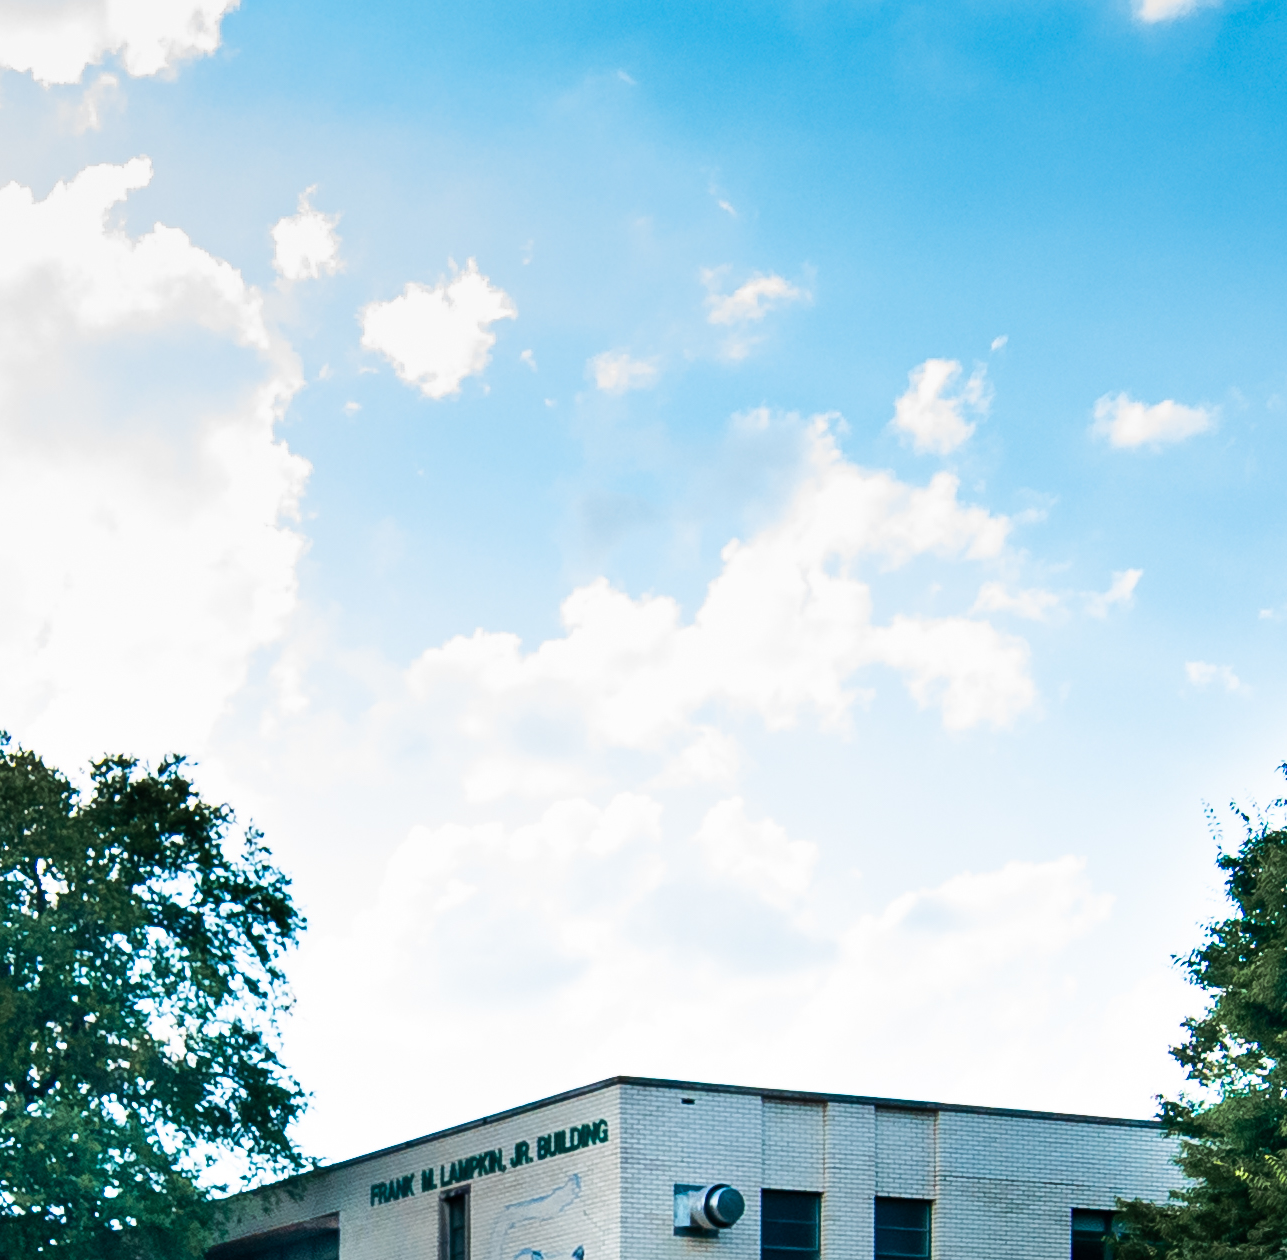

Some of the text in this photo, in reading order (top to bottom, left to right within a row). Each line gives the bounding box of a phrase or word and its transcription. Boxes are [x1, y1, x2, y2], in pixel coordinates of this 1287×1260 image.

[370, 1118, 609, 1207] FRANK M. LAMPKIN, JR. BUILDING
